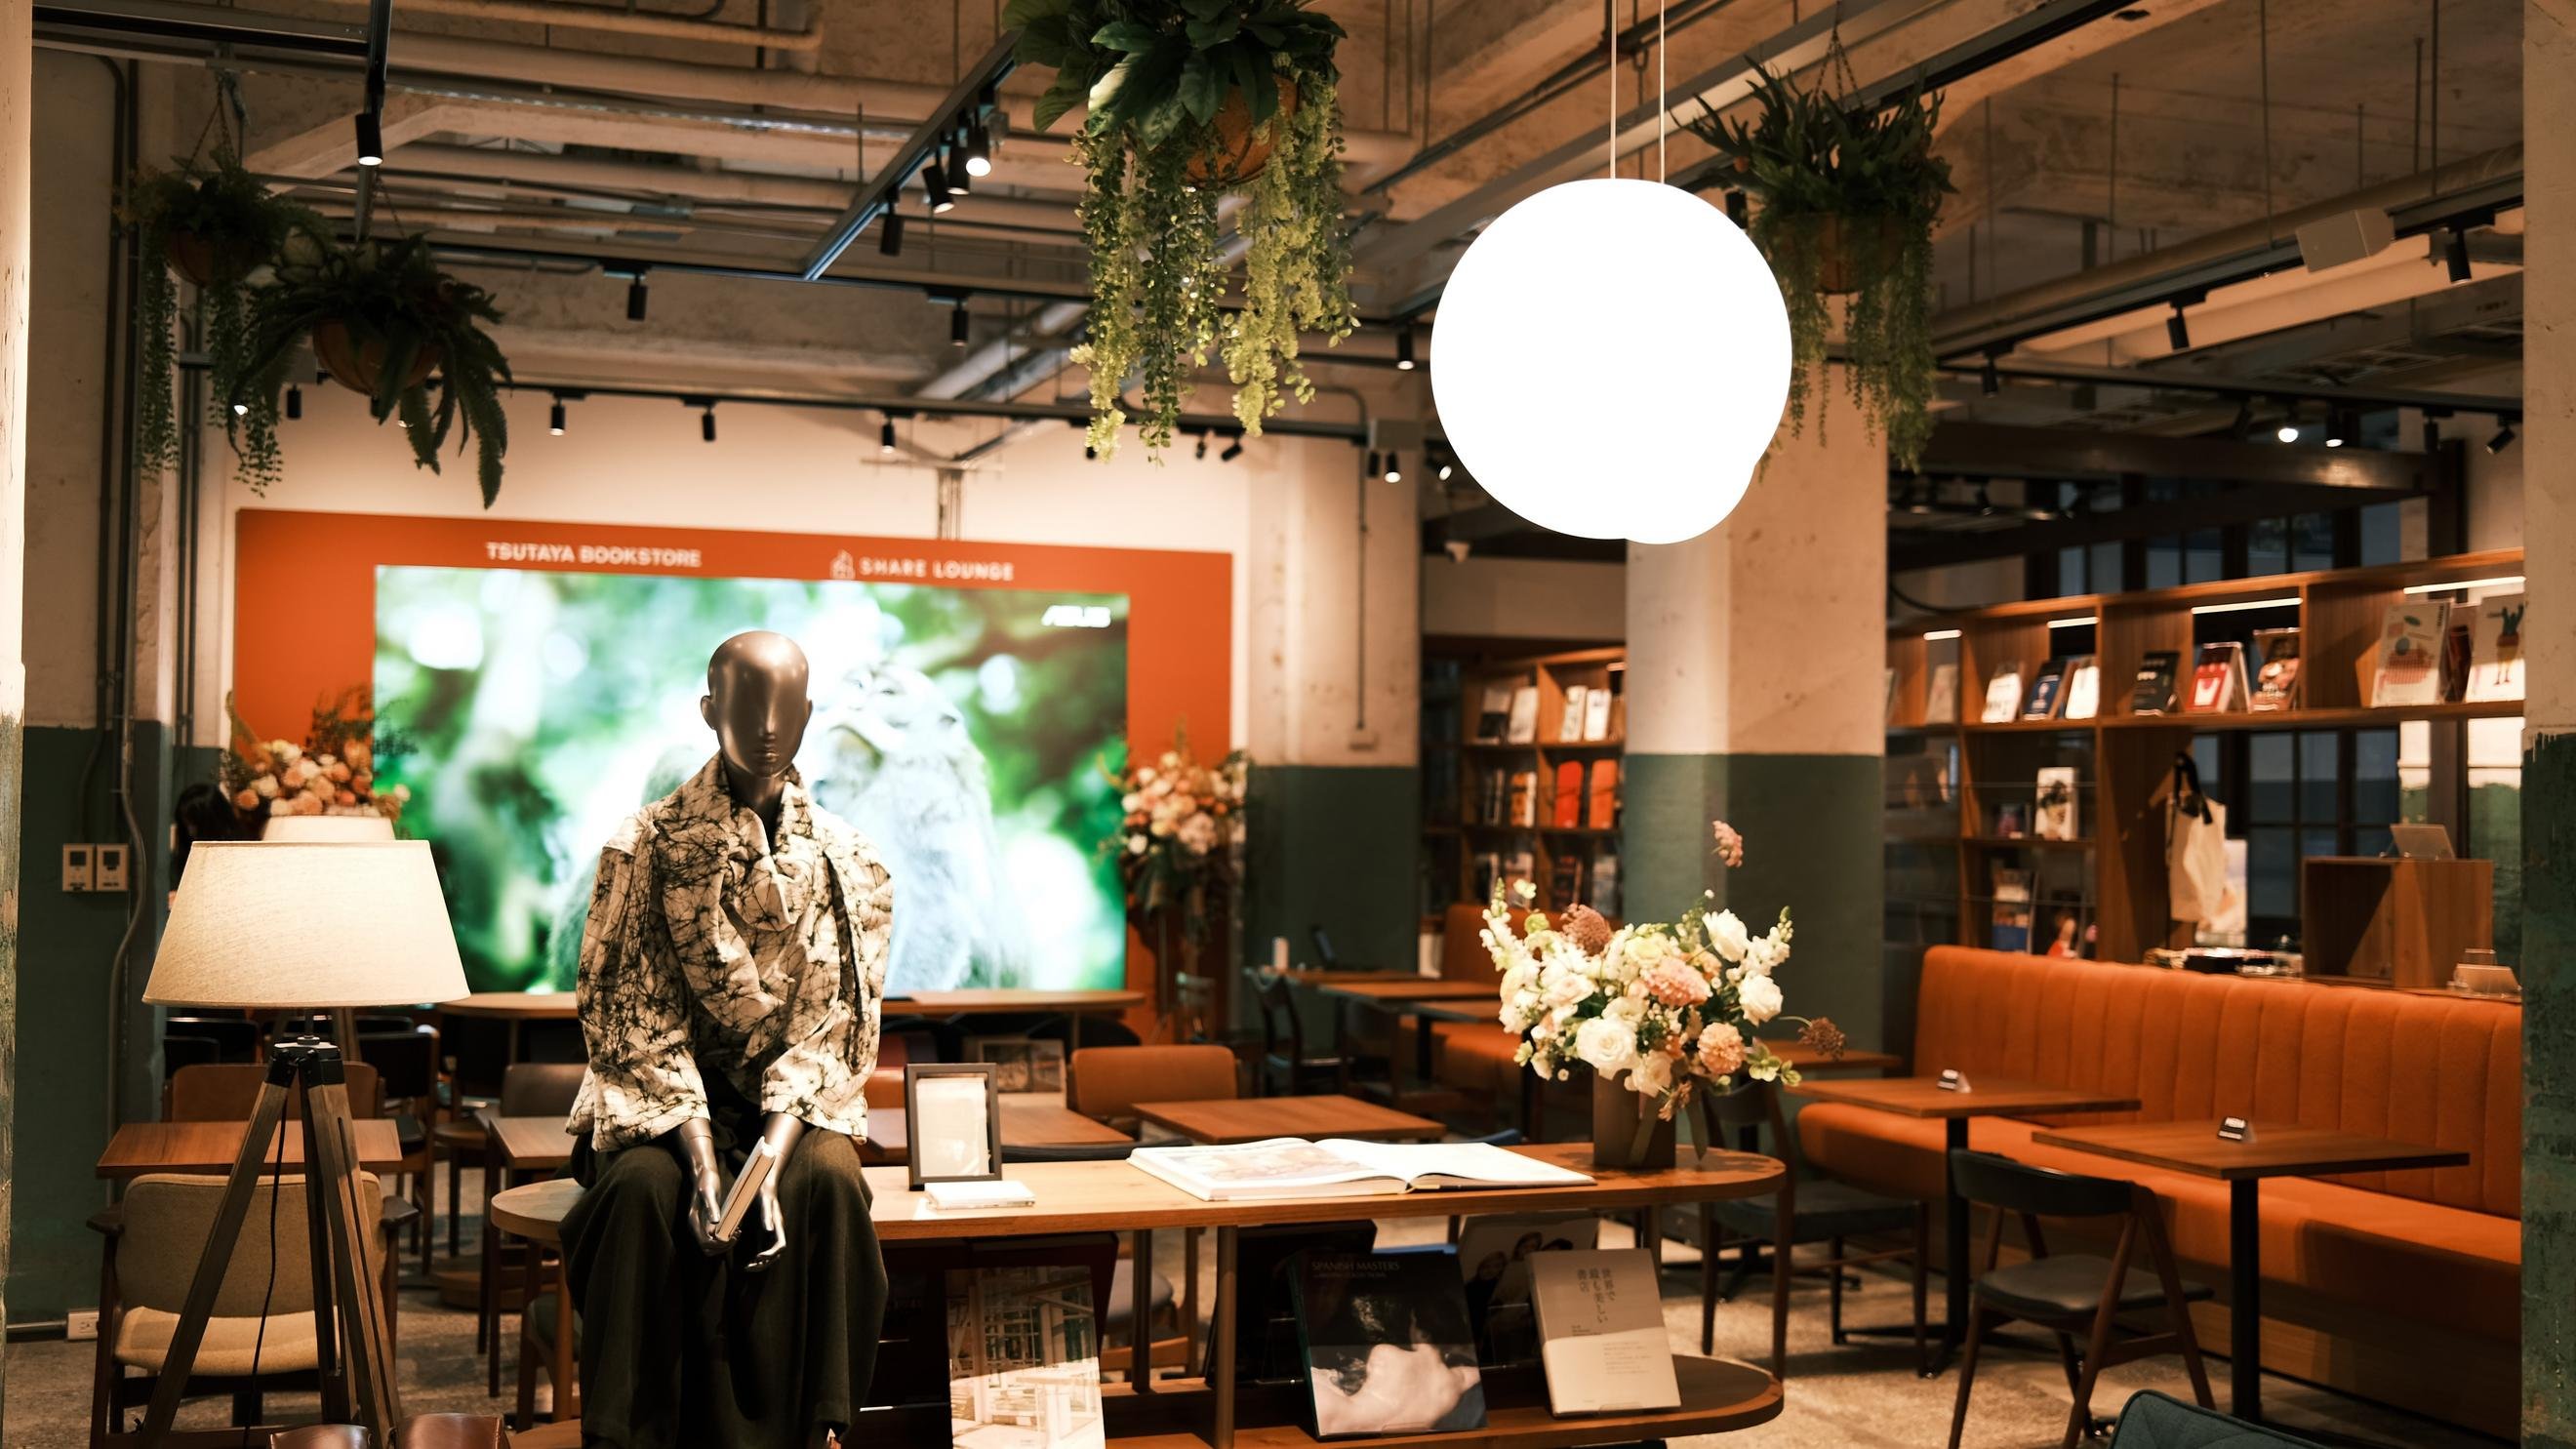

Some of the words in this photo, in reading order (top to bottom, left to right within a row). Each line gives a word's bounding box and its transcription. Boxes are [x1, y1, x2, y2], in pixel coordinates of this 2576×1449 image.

[486, 542, 575, 563] TSUTAYA
[579, 545, 703, 568] BOOKSTORE
[859, 556, 927, 578] SHARE
[932, 560, 1015, 582] LOUNGE
